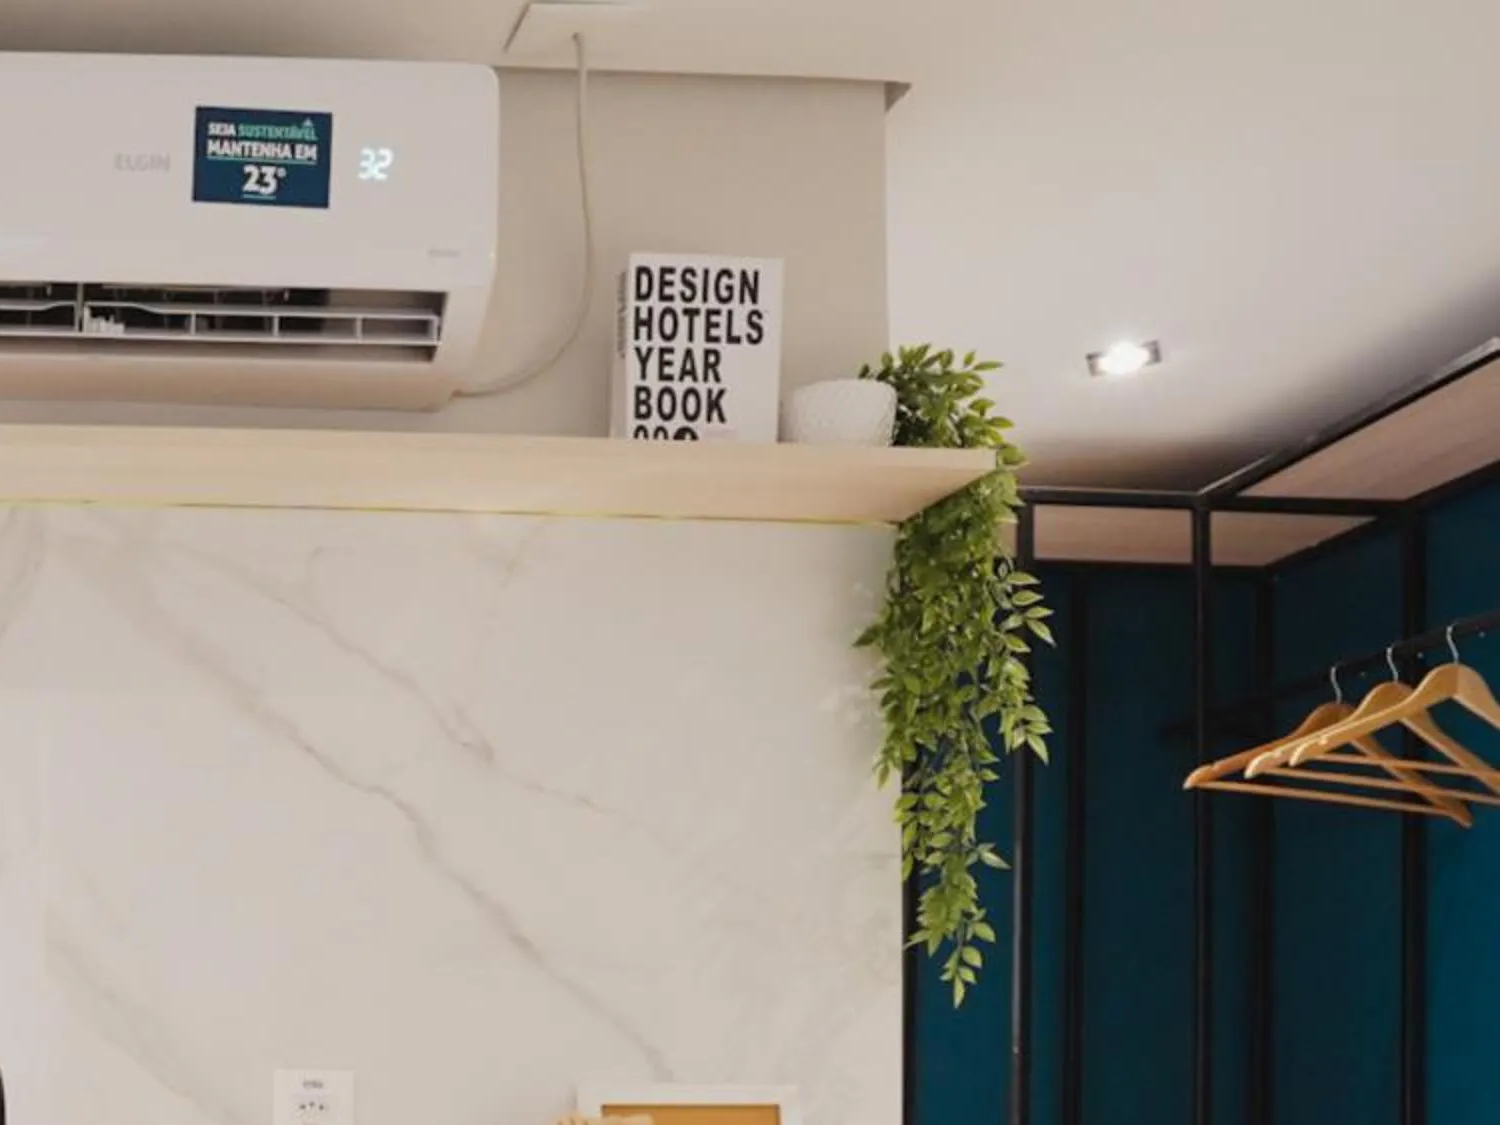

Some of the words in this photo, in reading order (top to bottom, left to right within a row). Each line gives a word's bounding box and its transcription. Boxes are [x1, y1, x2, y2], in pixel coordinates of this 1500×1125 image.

[208, 122, 237, 137] SEJA
[207, 139, 293, 159] MANTENHA
[295, 143, 317, 161] EM
[634, 265, 761, 305] DESIGN
[633, 306, 765, 346] HOTELS
[633, 346, 723, 384] YEAR
[633, 385, 728, 425] BOOK
